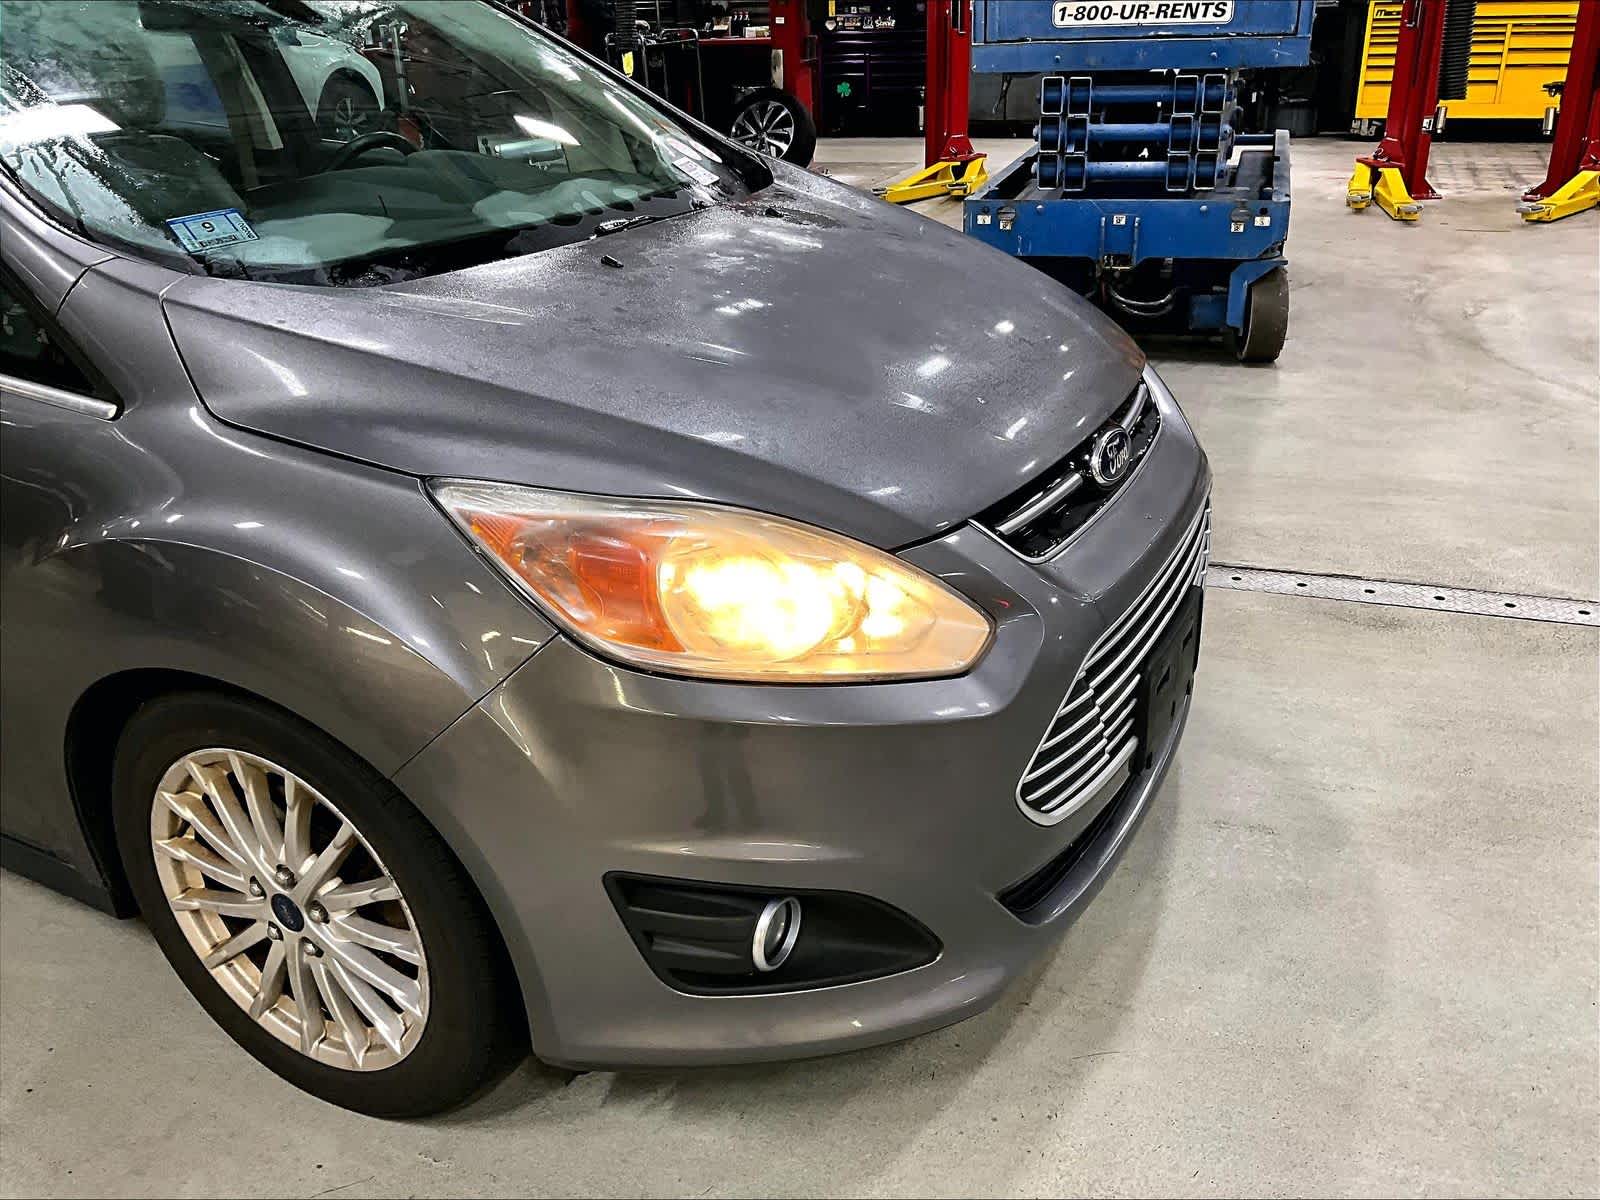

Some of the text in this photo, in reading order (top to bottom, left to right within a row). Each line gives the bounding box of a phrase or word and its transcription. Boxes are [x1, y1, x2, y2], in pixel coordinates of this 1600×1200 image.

[1058, 2, 1228, 21] 1-800-UR-RENTS
[201, 221, 215, 232] 9
[1107, 438, 1128, 475] Ford
